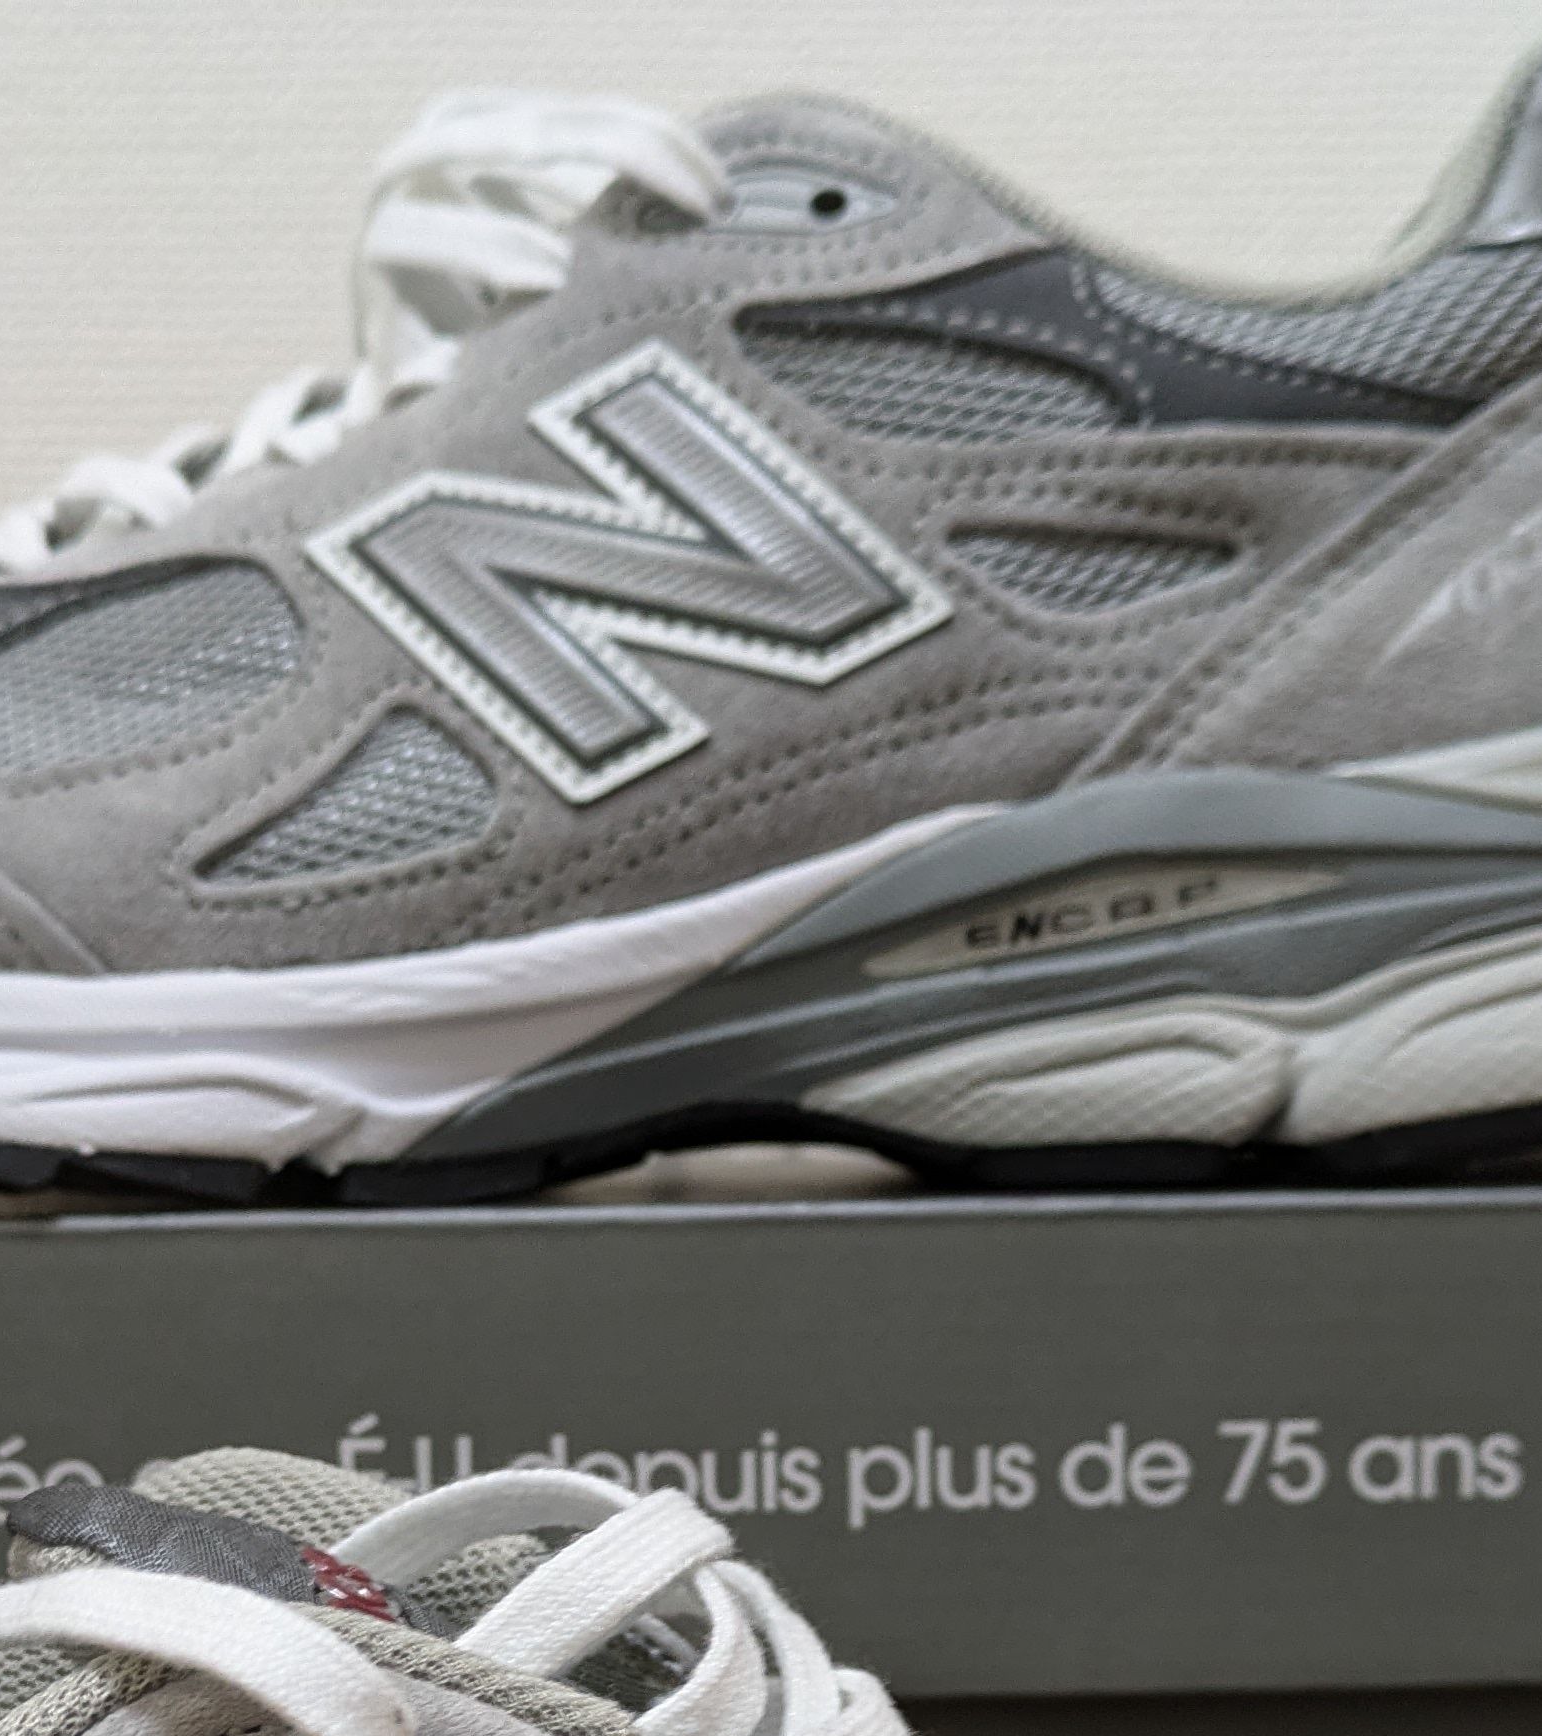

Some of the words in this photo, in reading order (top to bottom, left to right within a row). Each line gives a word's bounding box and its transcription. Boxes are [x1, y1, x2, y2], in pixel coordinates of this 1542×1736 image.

[304, 340, 956, 804] N
[846, 1425, 1038, 1531] plus
[1058, 1420, 1194, 1509] de
[1215, 1417, 1327, 1505] 75
[1347, 1430, 1524, 1503] ans
